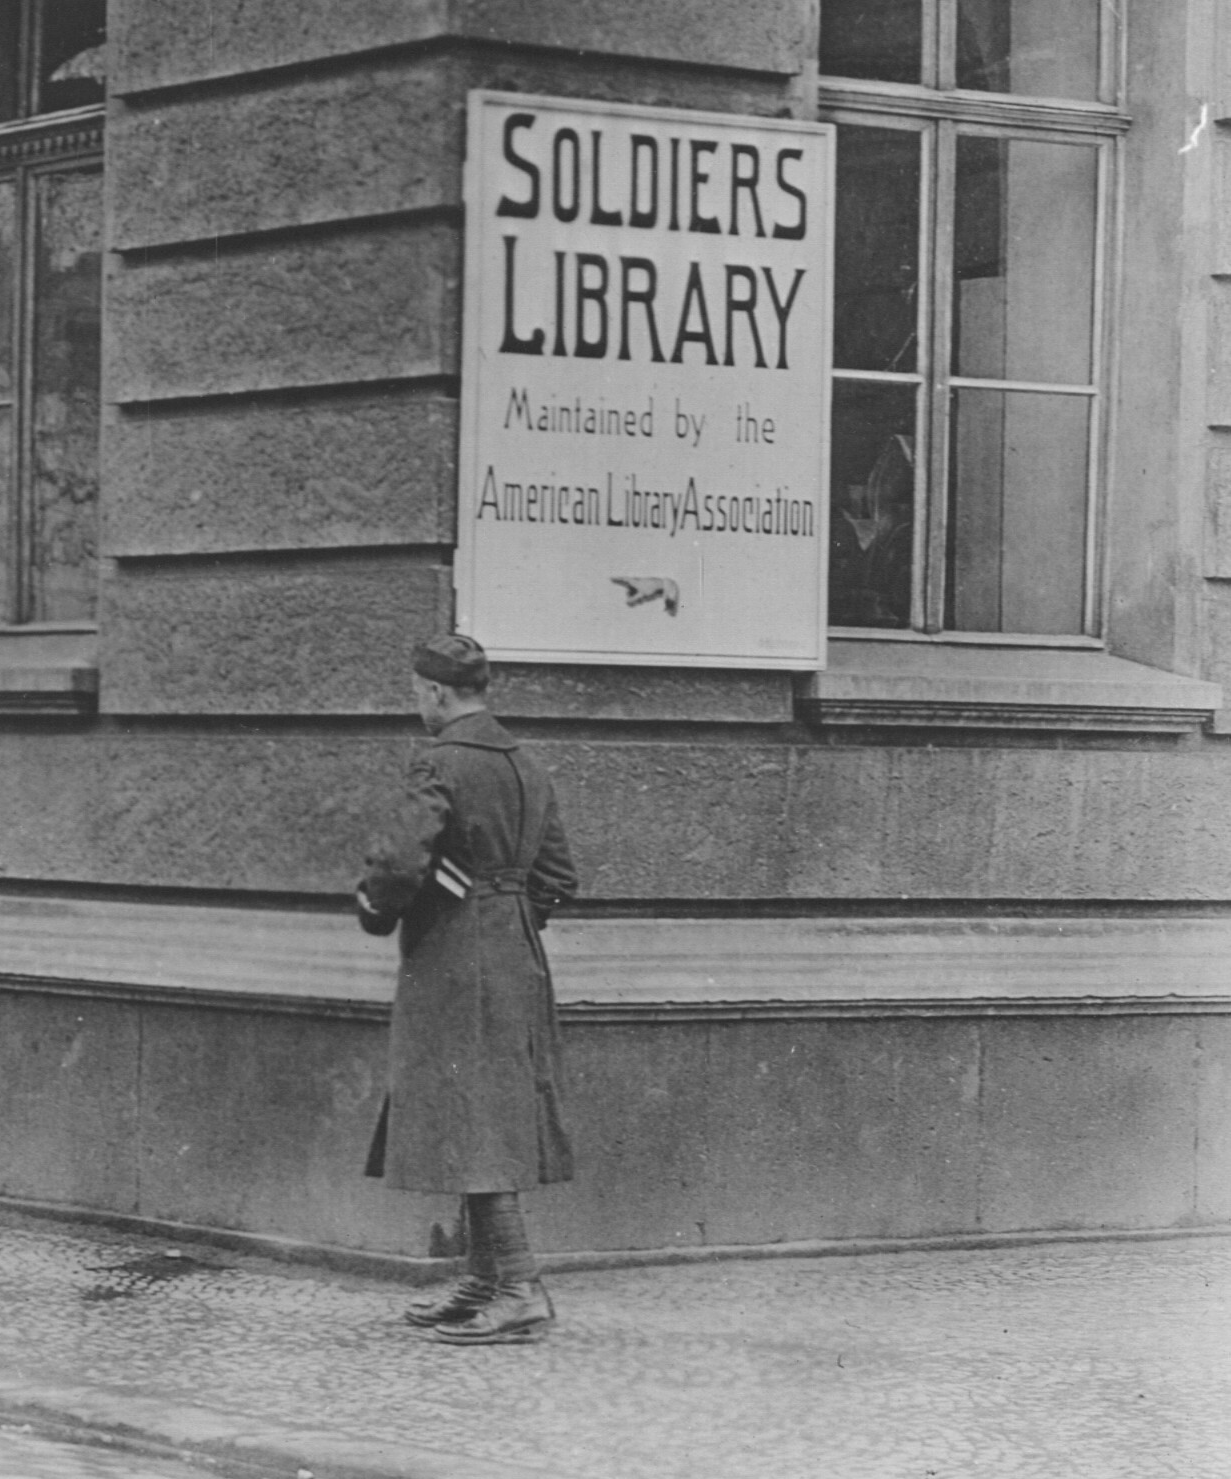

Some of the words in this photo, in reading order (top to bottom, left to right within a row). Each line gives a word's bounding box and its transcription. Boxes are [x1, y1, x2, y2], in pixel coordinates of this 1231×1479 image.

[496, 113, 807, 241] SOLDIERS
[498, 235, 807, 369] LIBRARY
[503, 387, 654, 437] Maintained
[675, 397, 706, 447] by
[735, 401, 776, 444] the
[477, 465, 600, 525] American
[606, 472, 682, 537] Library
[679, 477, 814, 536] Association
